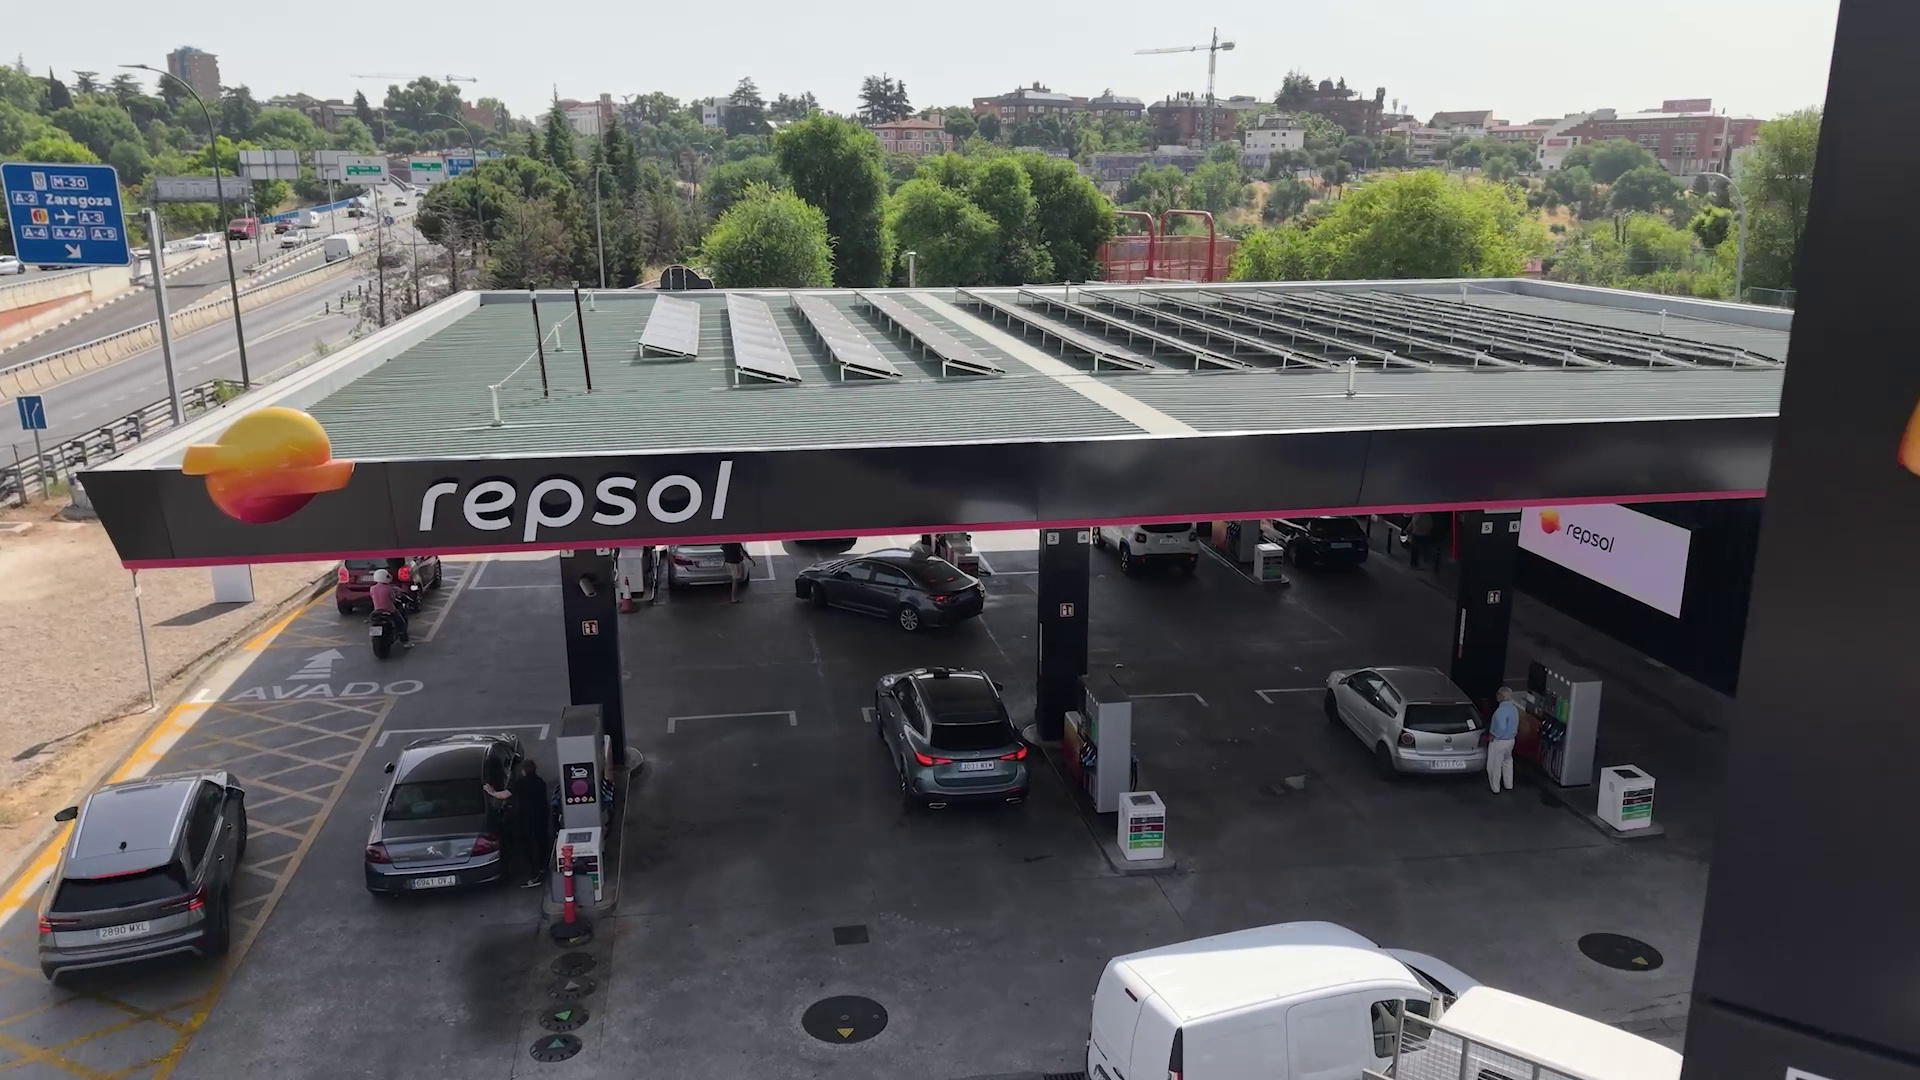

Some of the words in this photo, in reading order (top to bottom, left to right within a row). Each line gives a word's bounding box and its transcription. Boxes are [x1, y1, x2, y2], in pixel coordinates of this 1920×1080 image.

[53, 178, 85, 188] M-30
[15, 194, 36, 203] A-2
[45, 193, 113, 209] Zaragoza
[81, 213, 102, 223] A-3
[24, 227, 46, 237] A-4
[55, 228, 83, 238] A-42
[93, 229, 115, 239] A-5
[419, 460, 733, 542] repsol
[1566, 523, 1615, 553] repsol
[102, 926, 126, 937] 2890
[129, 923, 147, 932] MXL
